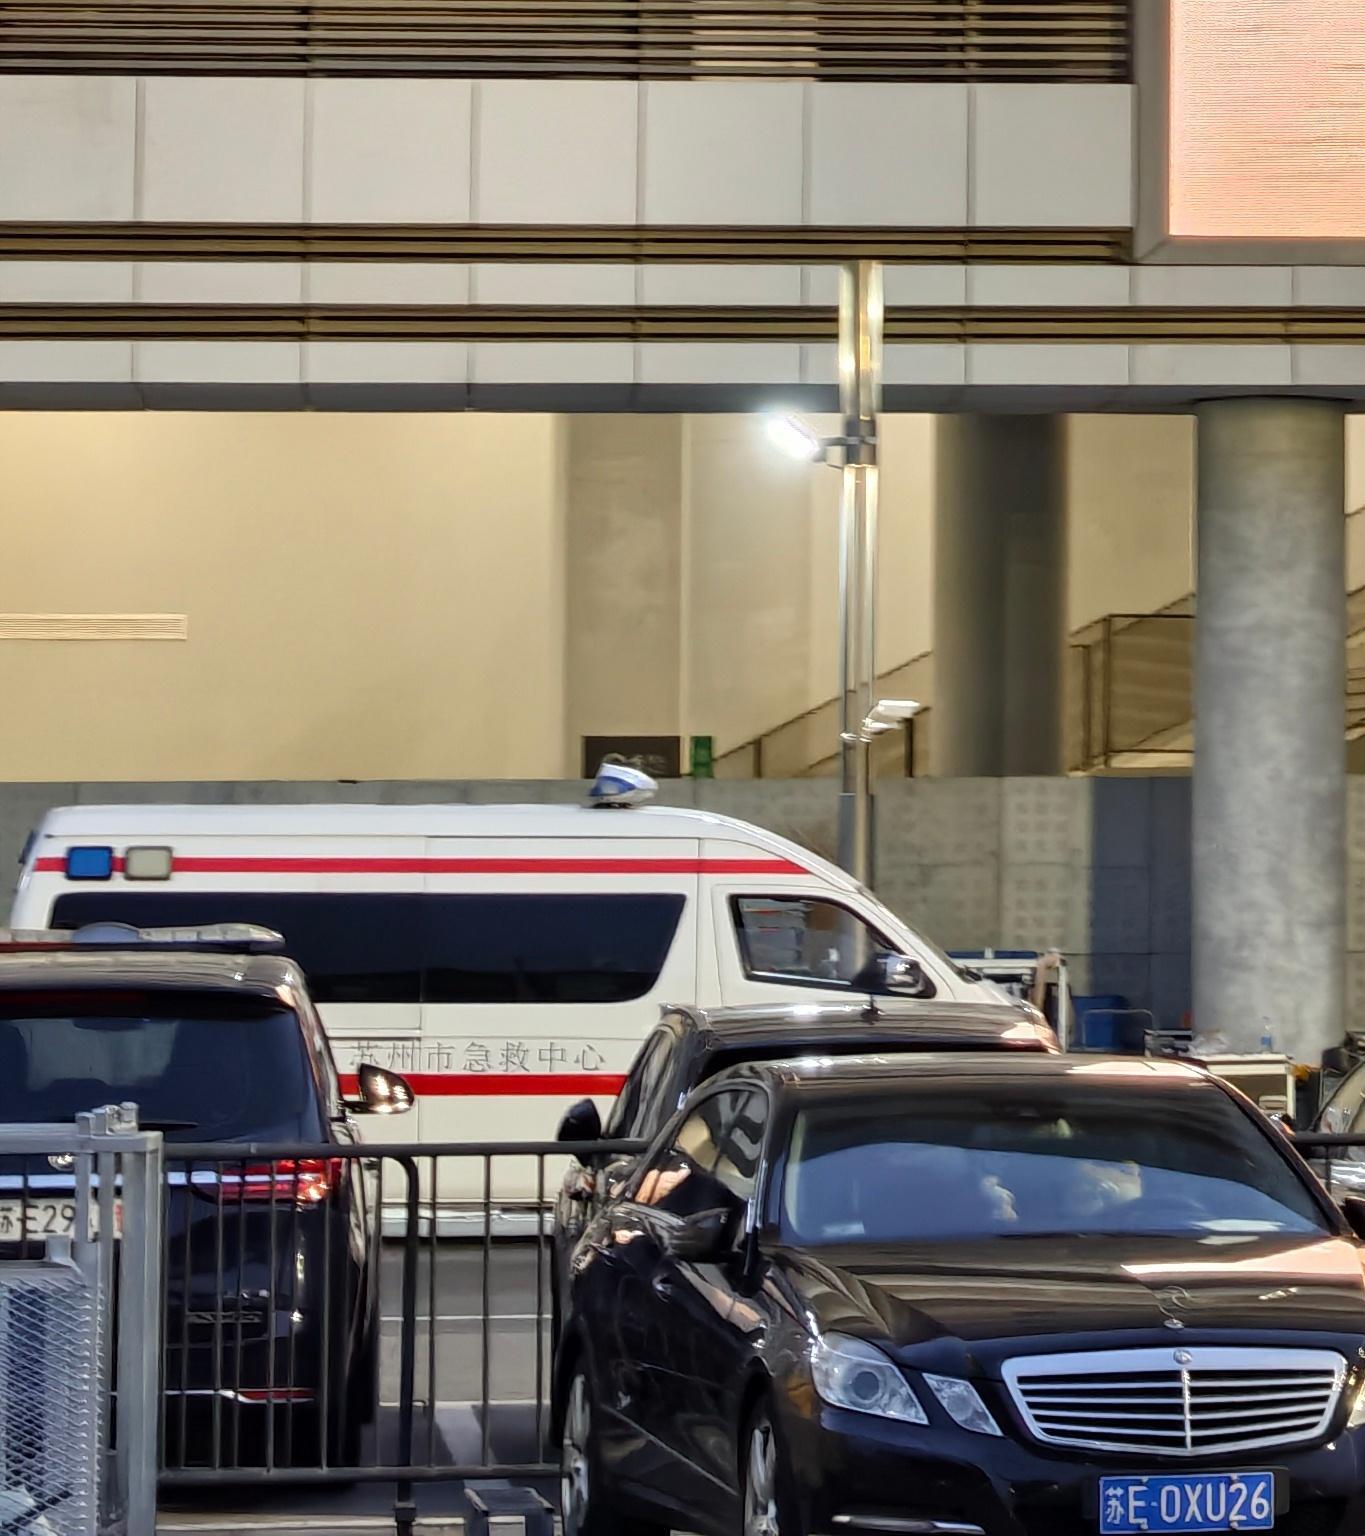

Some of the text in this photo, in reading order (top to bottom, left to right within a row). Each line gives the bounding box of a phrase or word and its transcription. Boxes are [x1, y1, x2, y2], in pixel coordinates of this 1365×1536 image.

[349, 1041, 606, 1073] 苏州市急救中心
